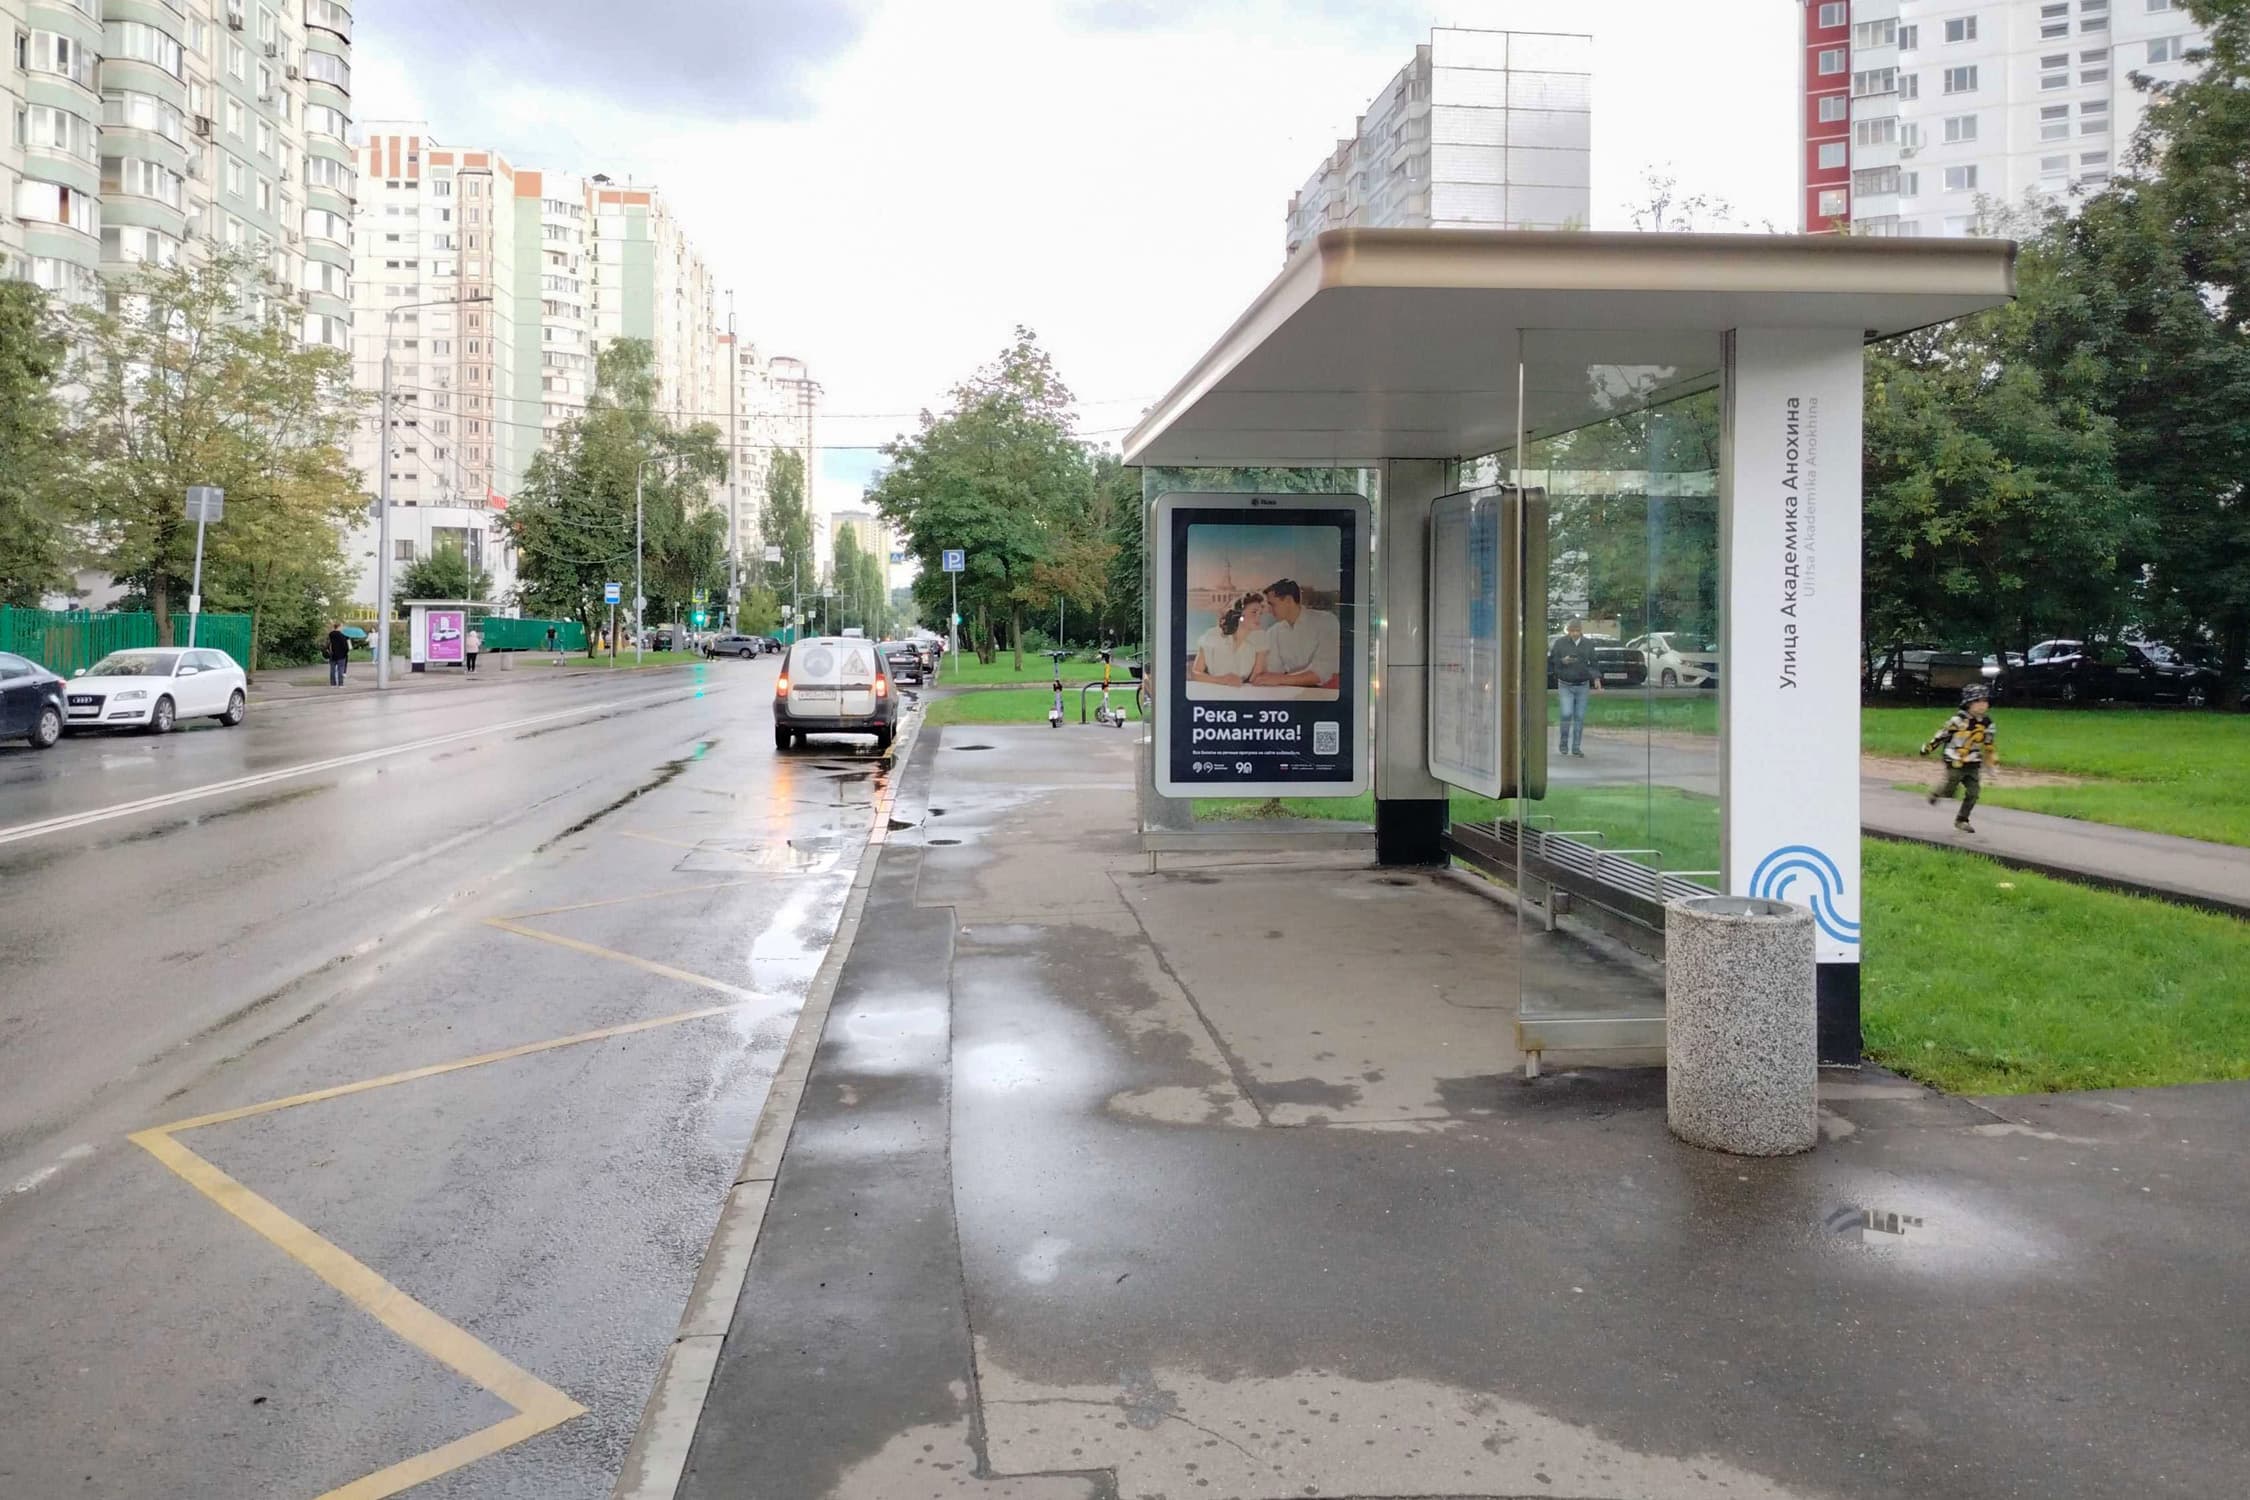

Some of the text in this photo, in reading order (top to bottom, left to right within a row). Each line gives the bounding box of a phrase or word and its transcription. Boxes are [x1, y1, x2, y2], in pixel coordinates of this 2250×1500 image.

[1780, 397, 1800, 689] Улица Академика Анохина
[1803, 397, 1819, 598] Ulitsa Akademika Anokhina
[1193, 706, 1237, 723] Река
[1259, 710, 1290, 723] это
[1193, 724, 1301, 744] романтика!
